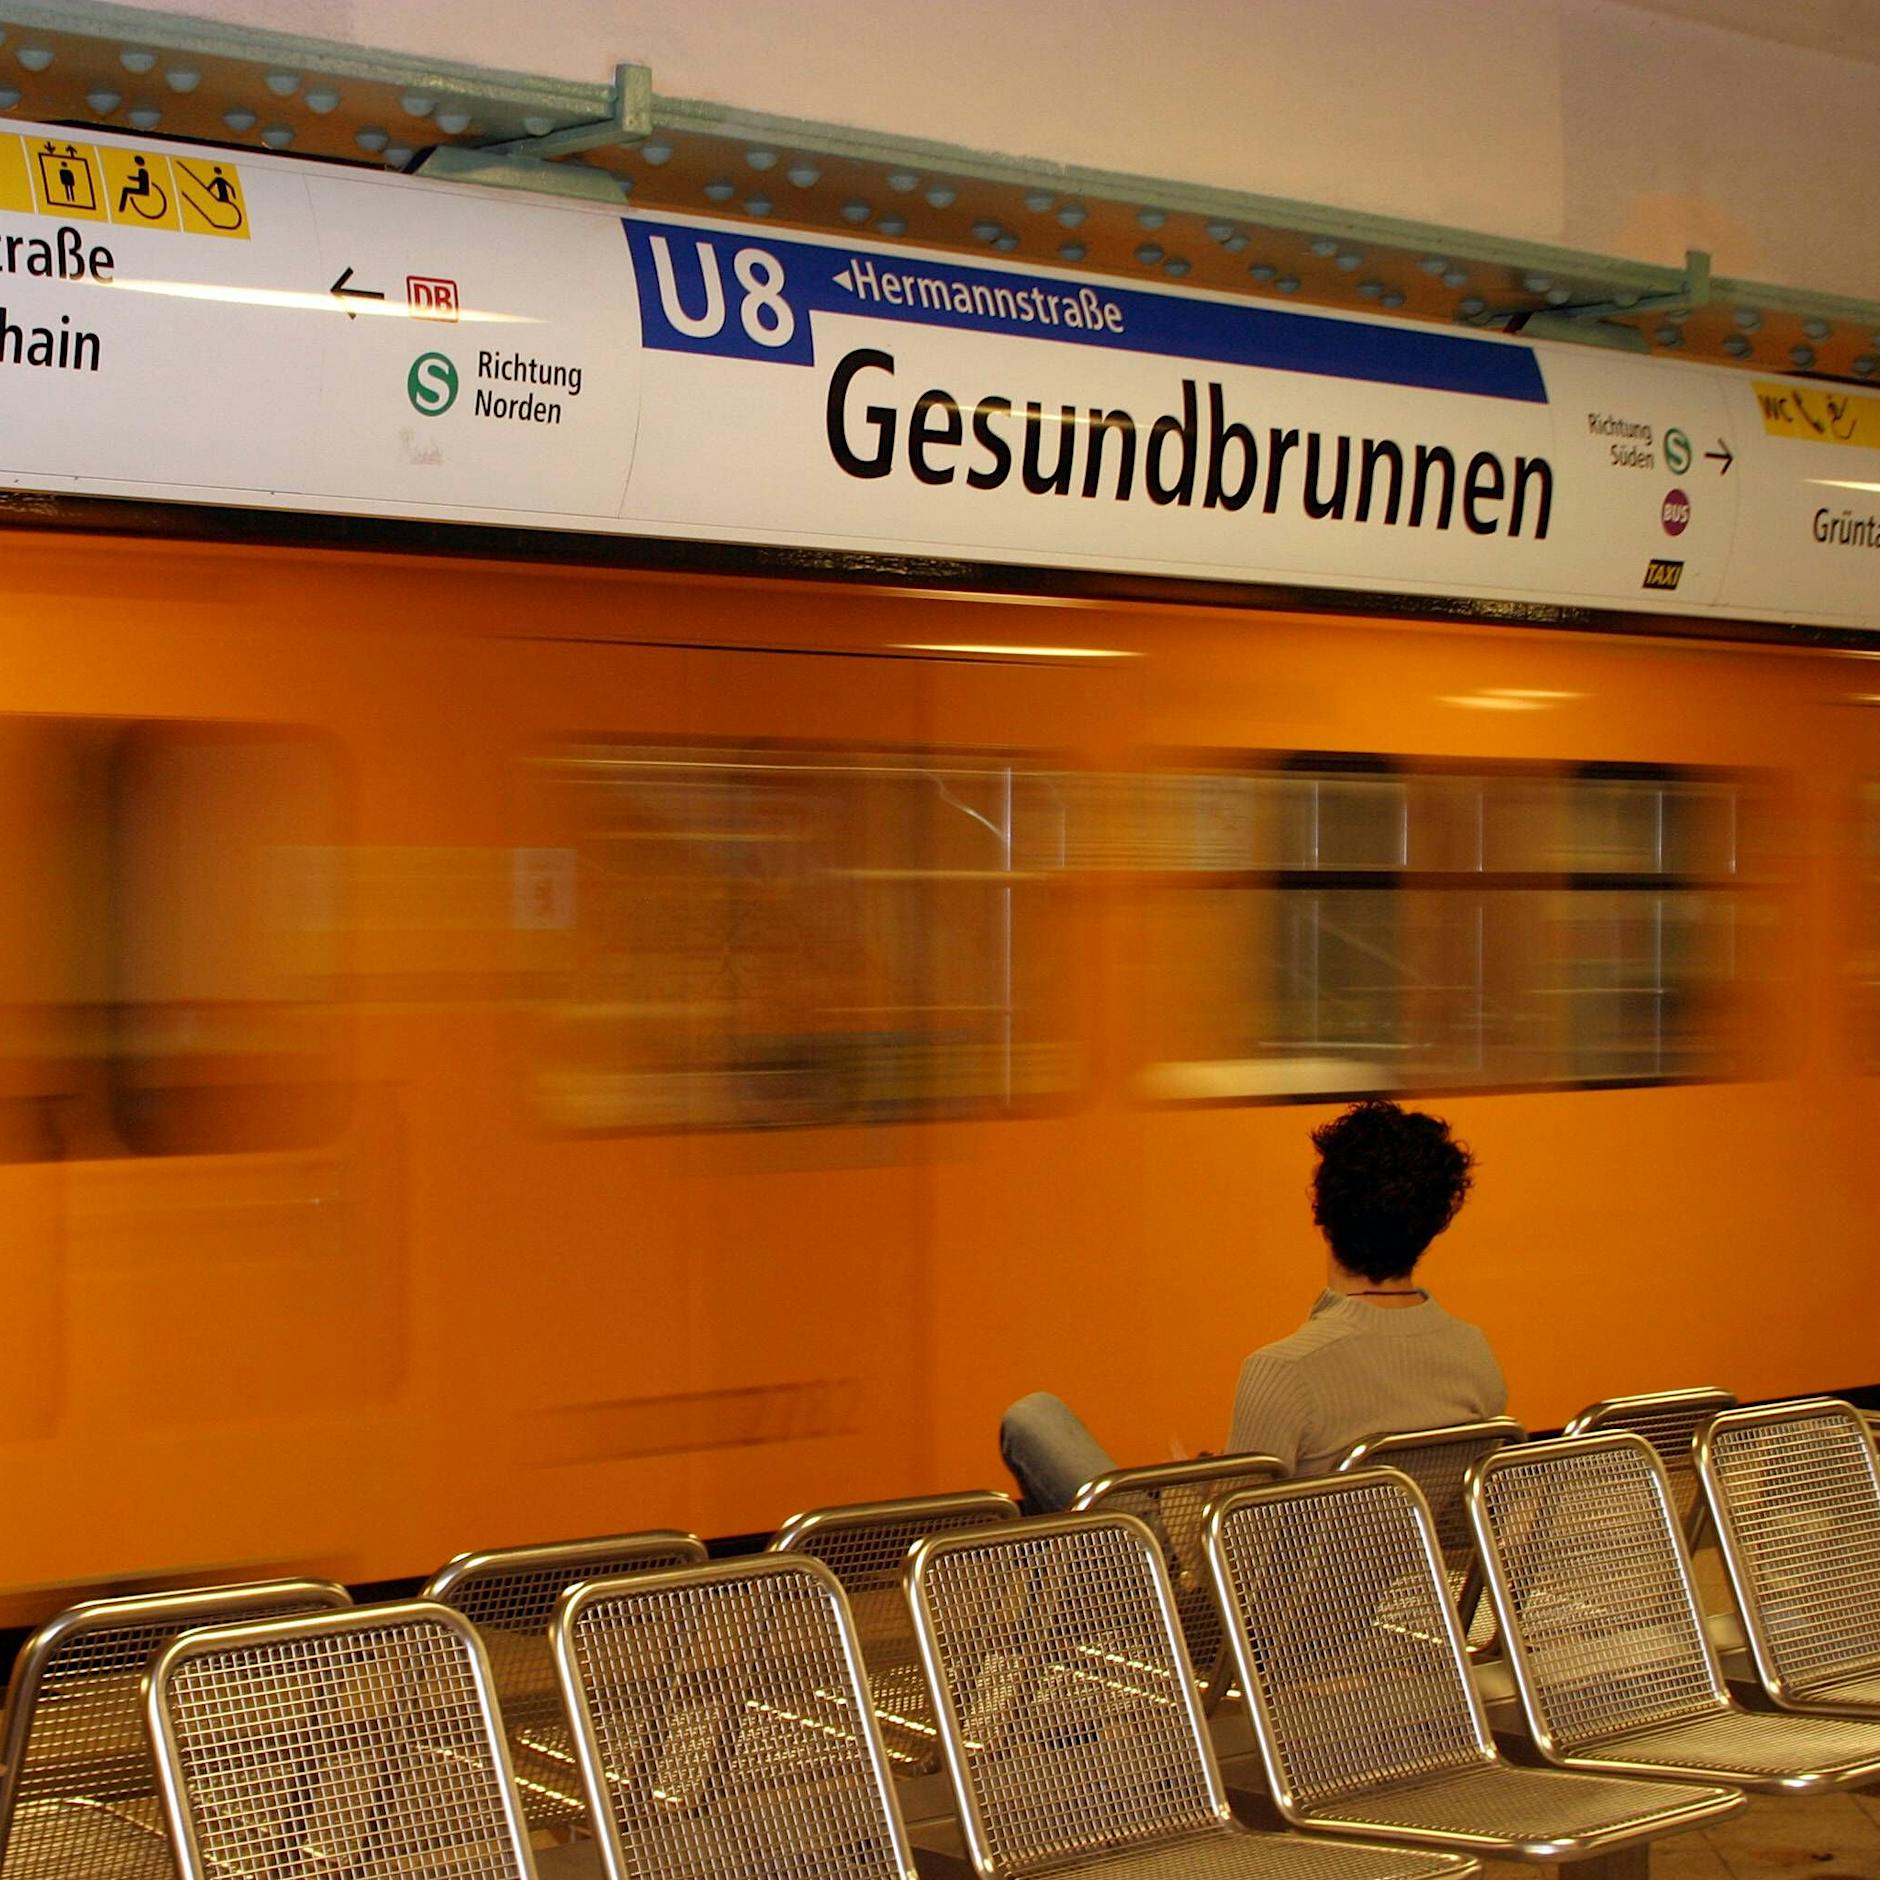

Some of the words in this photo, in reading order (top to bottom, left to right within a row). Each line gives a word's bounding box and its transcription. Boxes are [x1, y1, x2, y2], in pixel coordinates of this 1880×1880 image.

[0, 226, 115, 284] raße
[413, 283, 454, 318] DB
[649, 235, 796, 348] U8
[850, 258, 1125, 334] Hermannstraße
[478, 350, 583, 396] Richtung
[474, 389, 562, 425] Norden
[1760, 394, 1793, 422] WC
[825, 347, 1555, 541] Gesundbrunnen
[1588, 413, 1654, 446] Richtung
[1610, 444, 1655, 471] Süden
[1663, 502, 1689, 523] BUS
[1647, 564, 1680, 586] TAXI
